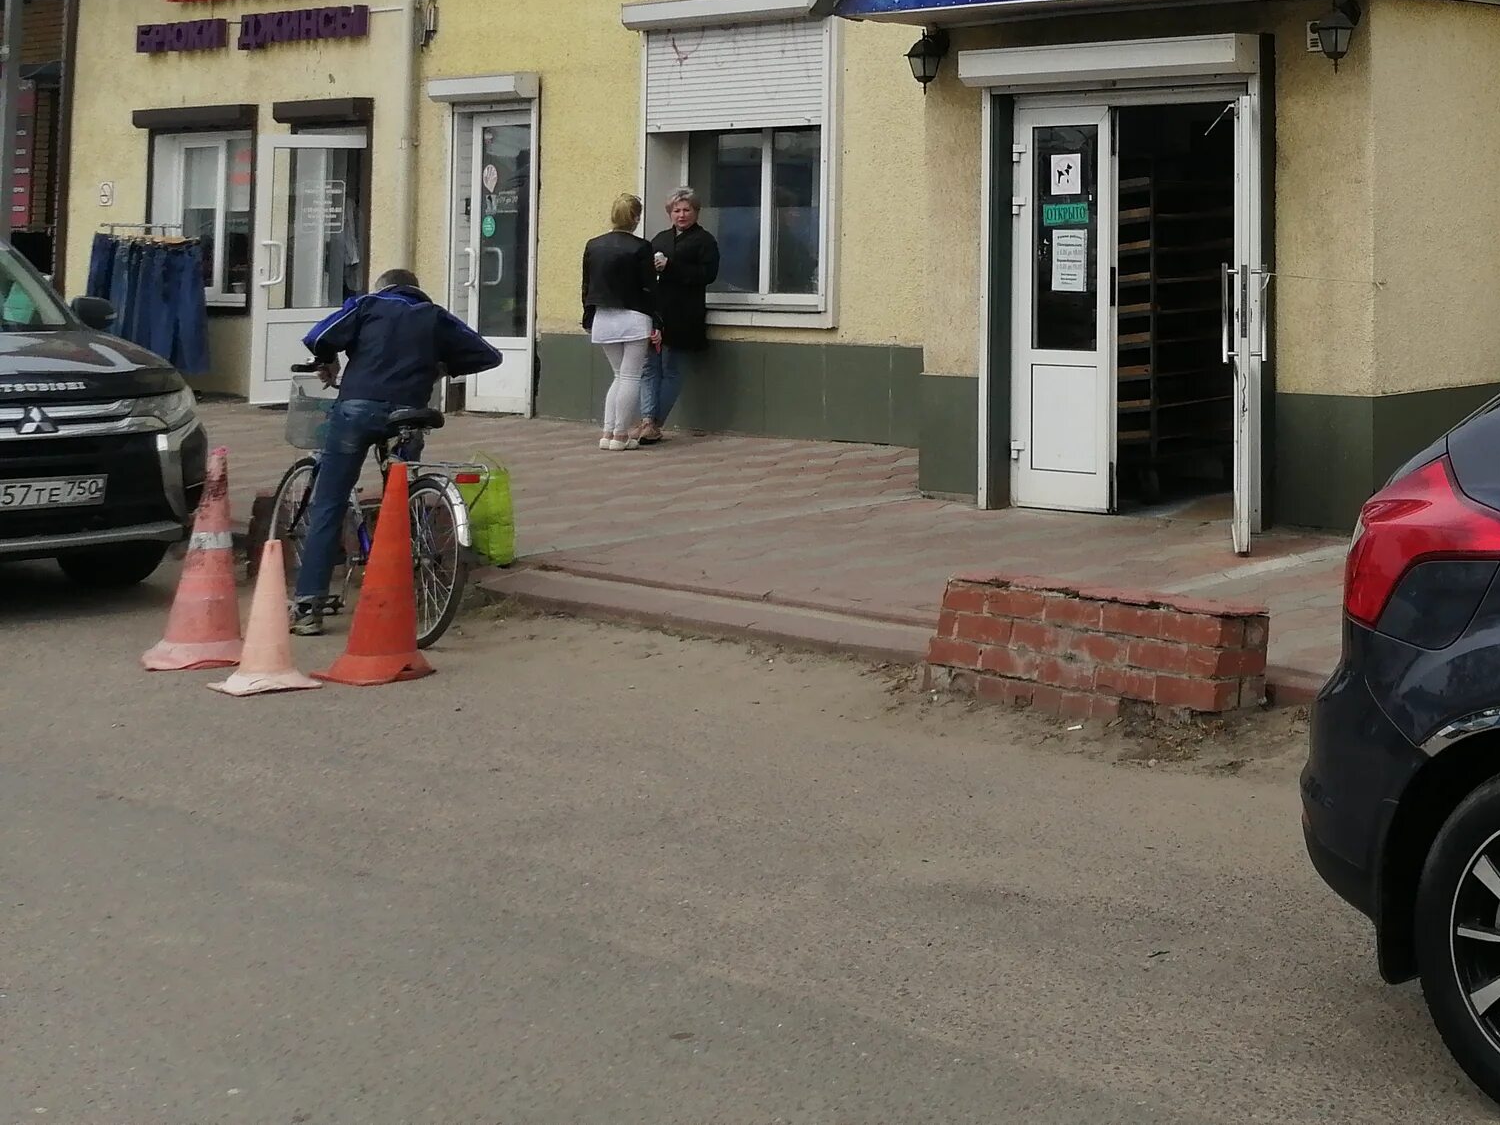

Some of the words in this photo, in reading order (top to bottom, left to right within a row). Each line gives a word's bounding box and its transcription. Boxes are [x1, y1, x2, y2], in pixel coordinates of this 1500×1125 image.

[137, 18, 227, 53] БРЮКИ
[238, 5, 369, 50] ДЖИНСЫ
[1046, 205, 1086, 221] ОТКРЫТО
[0, 381, 87, 393] TSUBISHI
